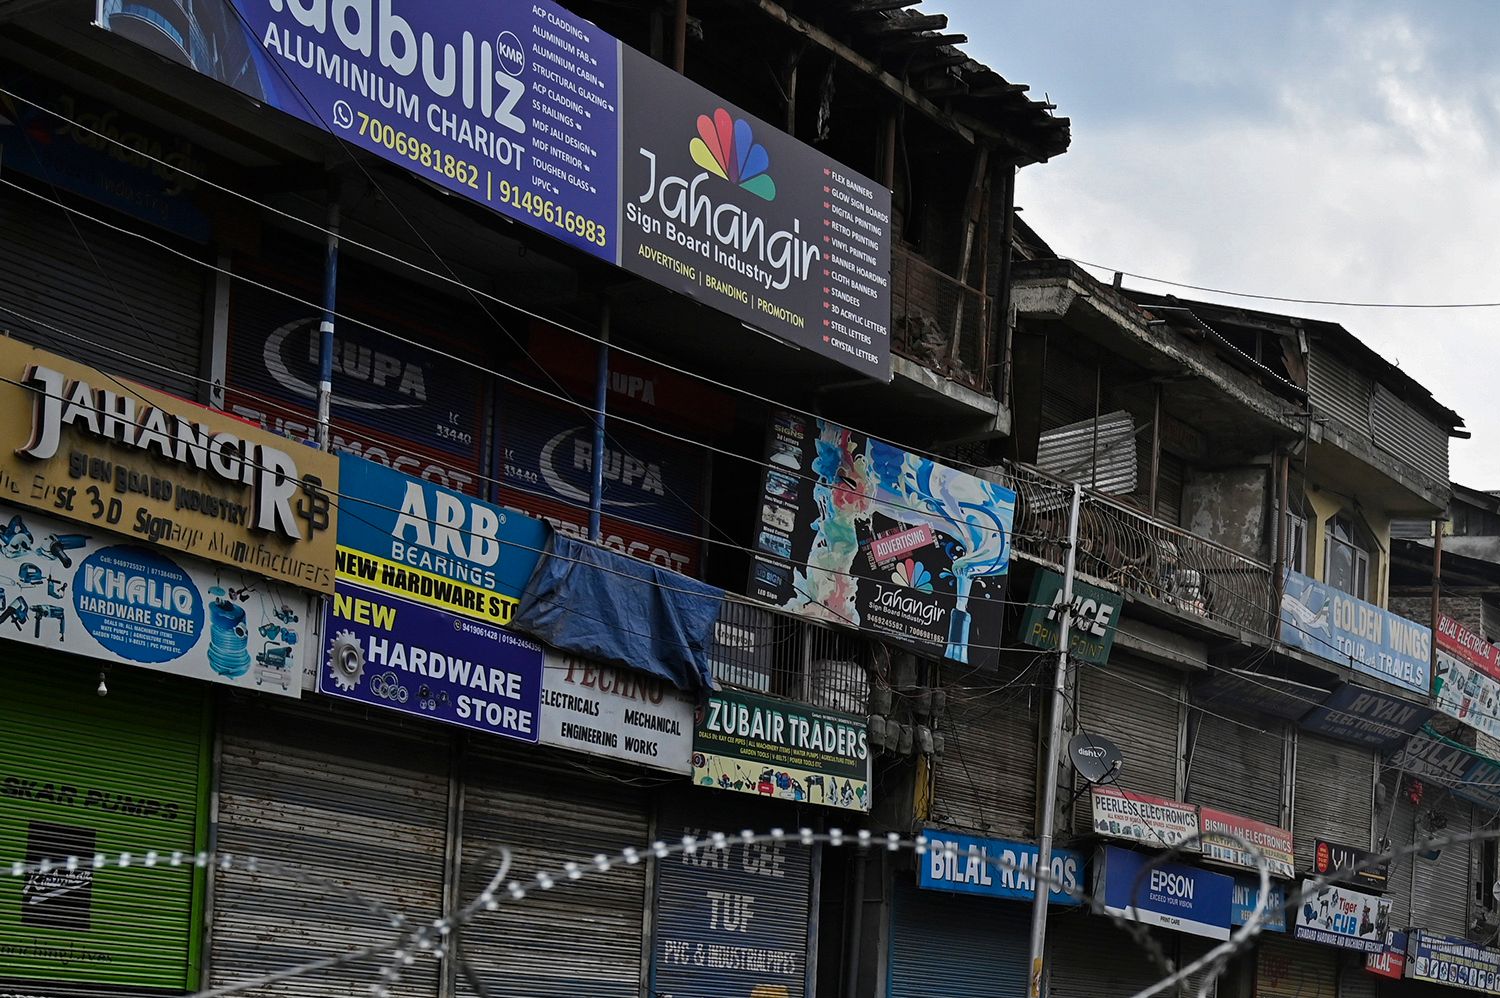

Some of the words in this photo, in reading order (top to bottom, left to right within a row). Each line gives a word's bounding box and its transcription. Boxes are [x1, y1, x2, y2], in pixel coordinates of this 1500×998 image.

[533, 5, 546, 18] ACP
[548, 11, 582, 40] CLADDING
[499, 42, 523, 66] KMR
[533, 25, 575, 52] ALUMINIUM
[576, 48, 592, 63] FAB.
[269, 0, 526, 134] adbullz
[533, 43, 575, 71] ALUMINIUM
[576, 66, 597, 86] CABIN
[263, 21, 419, 123] ALUMINIUM
[427, 103, 526, 171] CHARIOT
[533, 62, 576, 93] STRUCTURAL
[578, 85, 607, 110] GLAZING
[533, 82, 546, 95] ACP
[548, 89, 583, 115] CLADDING
[533, 99, 540, 110] SS
[542, 104, 573, 127] RAILINGS
[533, 119, 549, 133] MDF
[550, 126, 563, 141] JALI
[565, 132, 590, 155] DESIGN
[533, 138, 549, 152] MDF
[550, 145, 582, 169] INTERIOR
[357, 111, 478, 189] 7006981862
[500, 180, 606, 247] 9149616983
[532, 157, 566, 181] TOUGHEN
[568, 174, 589, 192] GLASS
[532, 176, 551, 191] UPVC
[832, 171, 845, 185] FLEX
[846, 179, 873, 199] BANNERS
[639, 147, 820, 290] Jahangir
[832, 188, 850, 203] GLOW
[851, 197, 864, 212] SIGN
[866, 206, 888, 223] BOARDS
[832, 205, 854, 222] DIGITAL
[855, 216, 882, 236] PRINTING
[626, 202, 661, 234] Sign
[666, 221, 710, 258] Board
[715, 245, 773, 289] Industry
[832, 221, 850, 237] RETRO
[852, 231, 878, 250] PRINTING
[832, 238, 848, 252] VINYL
[850, 246, 877, 266] PRINTING
[638, 244, 696, 280] ADVERTISING
[706, 275, 748, 304] BRANDING
[757, 298, 804, 328] PROMOTION
[832, 254, 855, 272] BANNER
[857, 267, 887, 286] HOARDING
[832, 271, 850, 286] CLOTH
[851, 280, 877, 298] BANNERS
[832, 288, 860, 306] STANDEES
[832, 304, 840, 314] 3D
[841, 308, 863, 326] ACRYLIC
[864, 320, 887, 335] LETTERS
[832, 321, 848, 334] STEEL
[849, 329, 872, 344] LETTERS
[831, 337, 854, 355] CRYSTAL
[856, 349, 878, 364] LETTERS
[14, 365, 301, 540] JAHANGIR
[574, 438, 665, 497] RUPA
[391, 480, 500, 567] ARB
[877, 529, 926, 557] ADVERTISING
[391, 541, 496, 589] BEARINGS
[84, 563, 193, 615] KHALIQ
[335, 550, 378, 581] NEW
[381, 561, 485, 613] HARDWARE
[489, 595, 519, 622] STO
[80, 595, 151, 625] HARDWARE
[155, 612, 194, 634] STORE
[333, 591, 397, 632] NEW
[868, 602, 882, 611] Sign
[883, 605, 900, 616] Board
[901, 612, 925, 626] Industry
[874, 584, 946, 626] Jahangir
[462, 623, 498, 641] 9419061428
[1333, 595, 1382, 645] GOLDEN
[1389, 618, 1429, 663] WINGS
[1440, 616, 1458, 640] BILAL
[1457, 628, 1491, 660] ELECTRICAL
[368, 635, 522, 700] HARDWARE
[1337, 635, 1365, 662] TOUR
[1378, 652, 1423, 687] TRAVELS
[564, 656, 665, 706] TECHNO
[456, 695, 532, 734] STORE
[541, 689, 600, 717] ELECTRICALS
[561, 721, 618, 748] ENGINEERING
[624, 736, 658, 757] WORKS
[624, 708, 681, 737] MECHANICAL
[706, 698, 785, 744] ZUBAIR
[787, 713, 868, 760] TRADERS
[84, 790, 178, 820] PUMPS
[1095, 796, 1139, 817] PEERLESS
[1141, 804, 1196, 827] ELECTRONICS
[1205, 819, 1244, 839] BISMILLAH
[1245, 829, 1291, 853] ELECTRONICS
[931, 839, 992, 886] BILAL
[1150, 869, 1195, 899] EPSON
[1150, 893, 1167, 904] EXCEED
[1167, 897, 1179, 907] YOUR
[1179, 900, 1193, 909] VISION
[706, 890, 754, 932] TUF
[1160, 915, 1170, 924] PRINT
[1170, 918, 1180, 926] CARE
[1340, 897, 1357, 914] Tiger
[1333, 913, 1357, 935] CUB
[664, 940, 689, 964] PVC
[1367, 952, 1391, 972] BILAL
